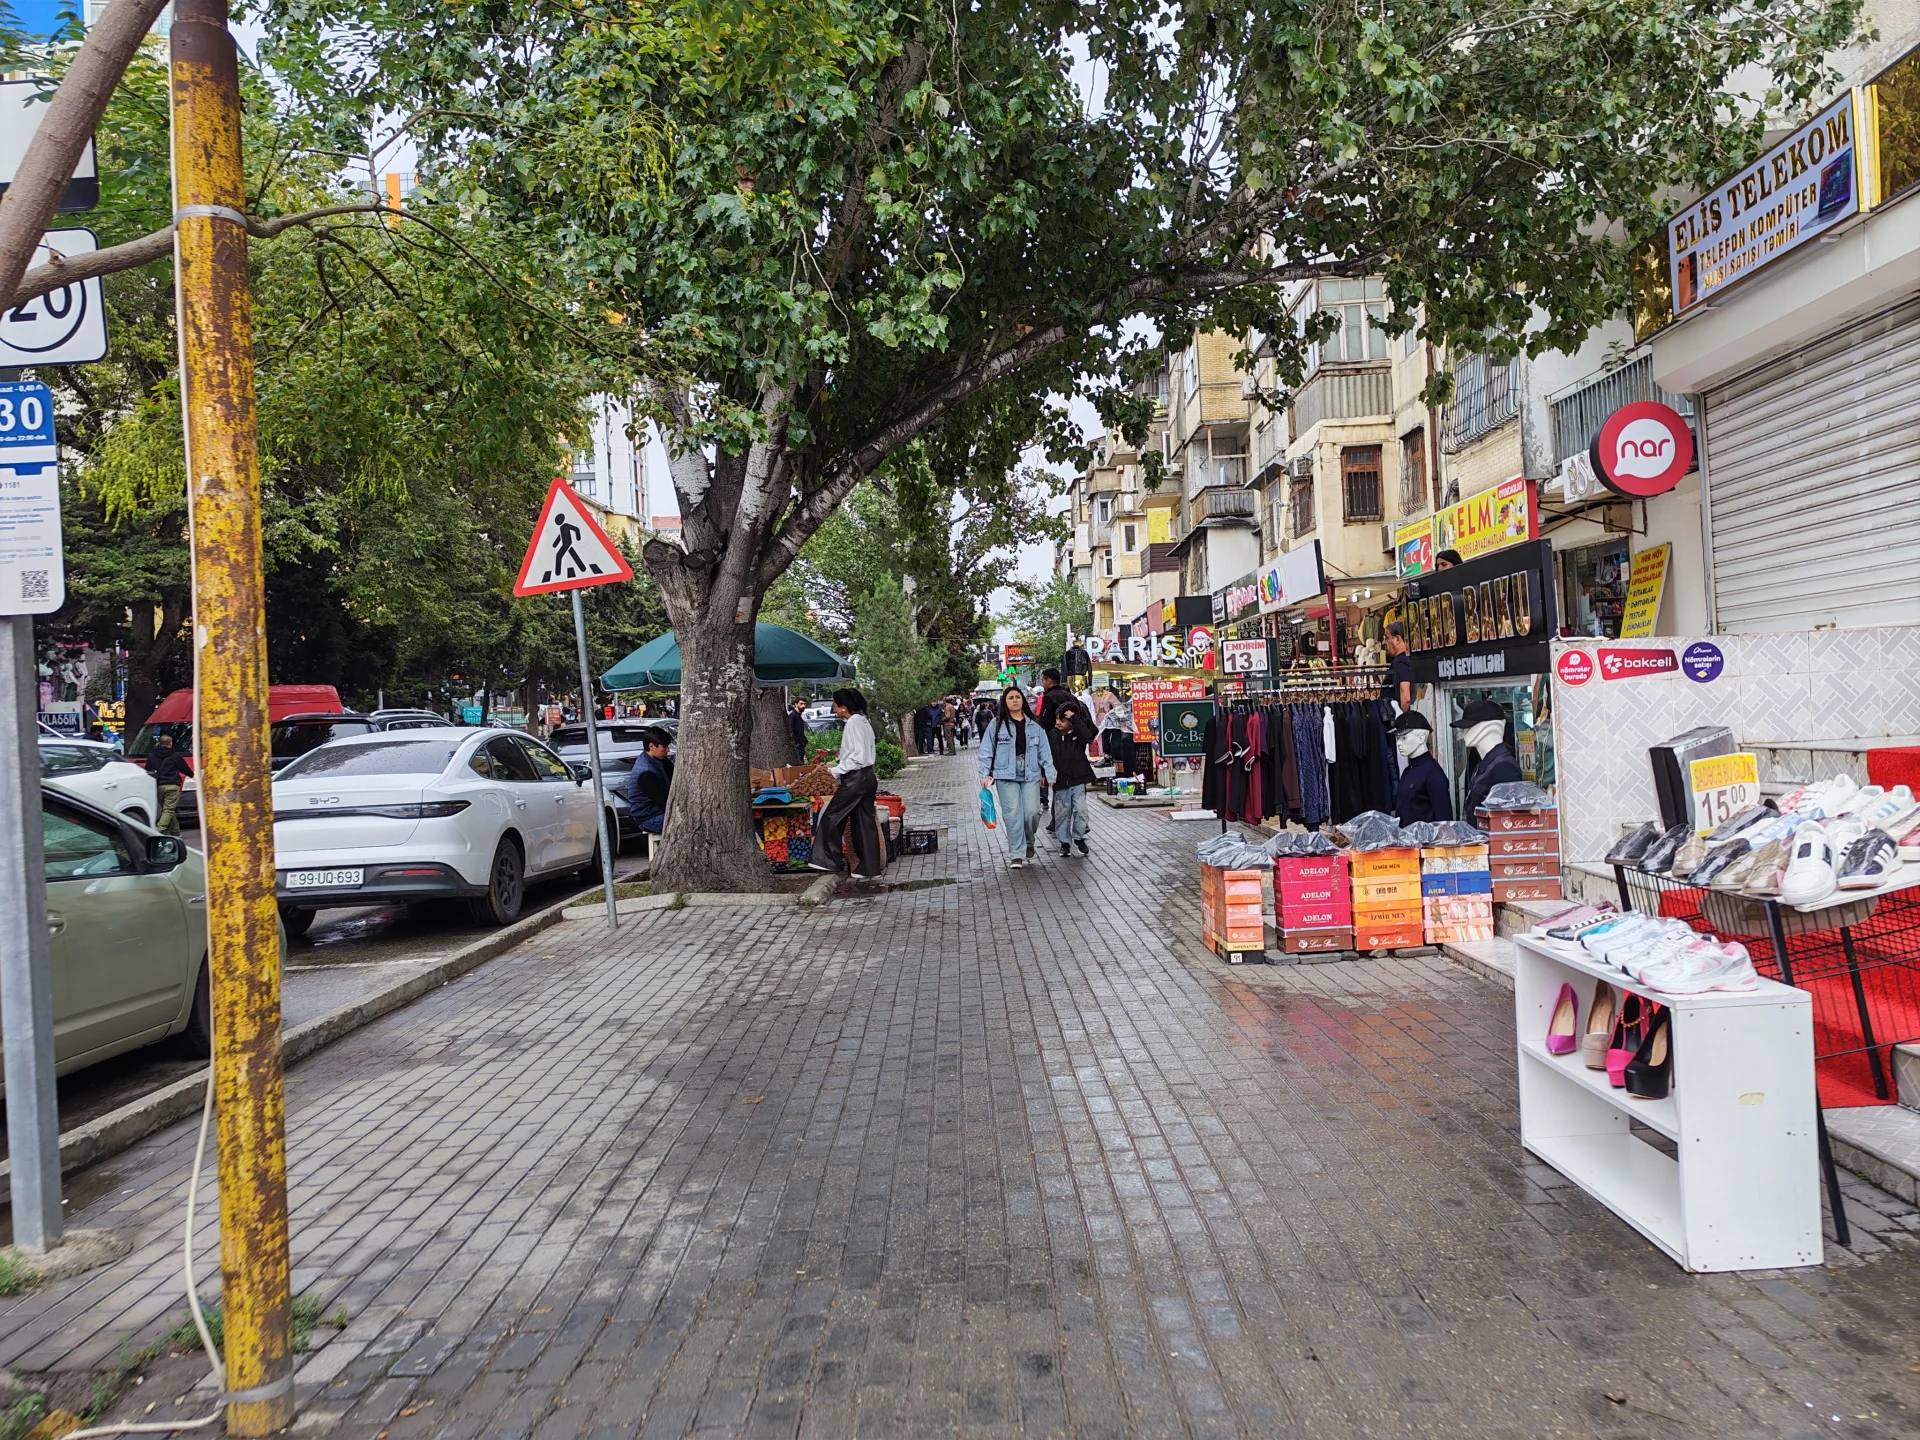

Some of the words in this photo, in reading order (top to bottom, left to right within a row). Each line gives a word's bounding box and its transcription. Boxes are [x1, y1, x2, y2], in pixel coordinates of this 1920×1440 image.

[1727, 107, 1850, 219] TELEKOM
[1699, 228, 1745, 272] TELEFON
[1749, 182, 1817, 242] KOMPÜTER
[1729, 243, 1760, 275] SATIŞI
[1763, 215, 1800, 256] TƏMİRİ
[1621, 438, 1670, 459] nar
[4, 481, 20, 489] 1181
[1396, 583, 1458, 657] TREND
[1462, 570, 1531, 644] BAKU
[1086, 624, 1178, 662] PARİS
[1225, 641, 1266, 652] ENDİRİM
[1225, 652, 1254, 671] 13
[1438, 655, 1456, 680] KİŞİ
[1456, 649, 1506, 676] GEYİMLƏRİ
[1624, 656, 1672, 669] bakcell
[1684, 655, 1721, 664] Nömrələrin
[1564, 673, 1588, 681] burada
[1133, 681, 1173, 691] MƏKTƏB
[1132, 691, 1154, 700] OFİS
[1155, 691, 1202, 700] LƏVAZİMATLARI
[1520, 753, 1532, 770] 10
[1733, 755, 1756, 781] GÜN
[309, 796, 340, 805] BYD
[1299, 867, 1330, 876] ADELON
[1372, 863, 1388, 871] İZMİR
[298, 870, 360, 886] 99-UQ-693
[1300, 891, 1331, 899] ADELON
[1428, 887, 1446, 895] AKM
[1302, 914, 1333, 922] ADELON
[1370, 912, 1390, 921] İZMİR
[1391, 911, 1405, 919] MEN
